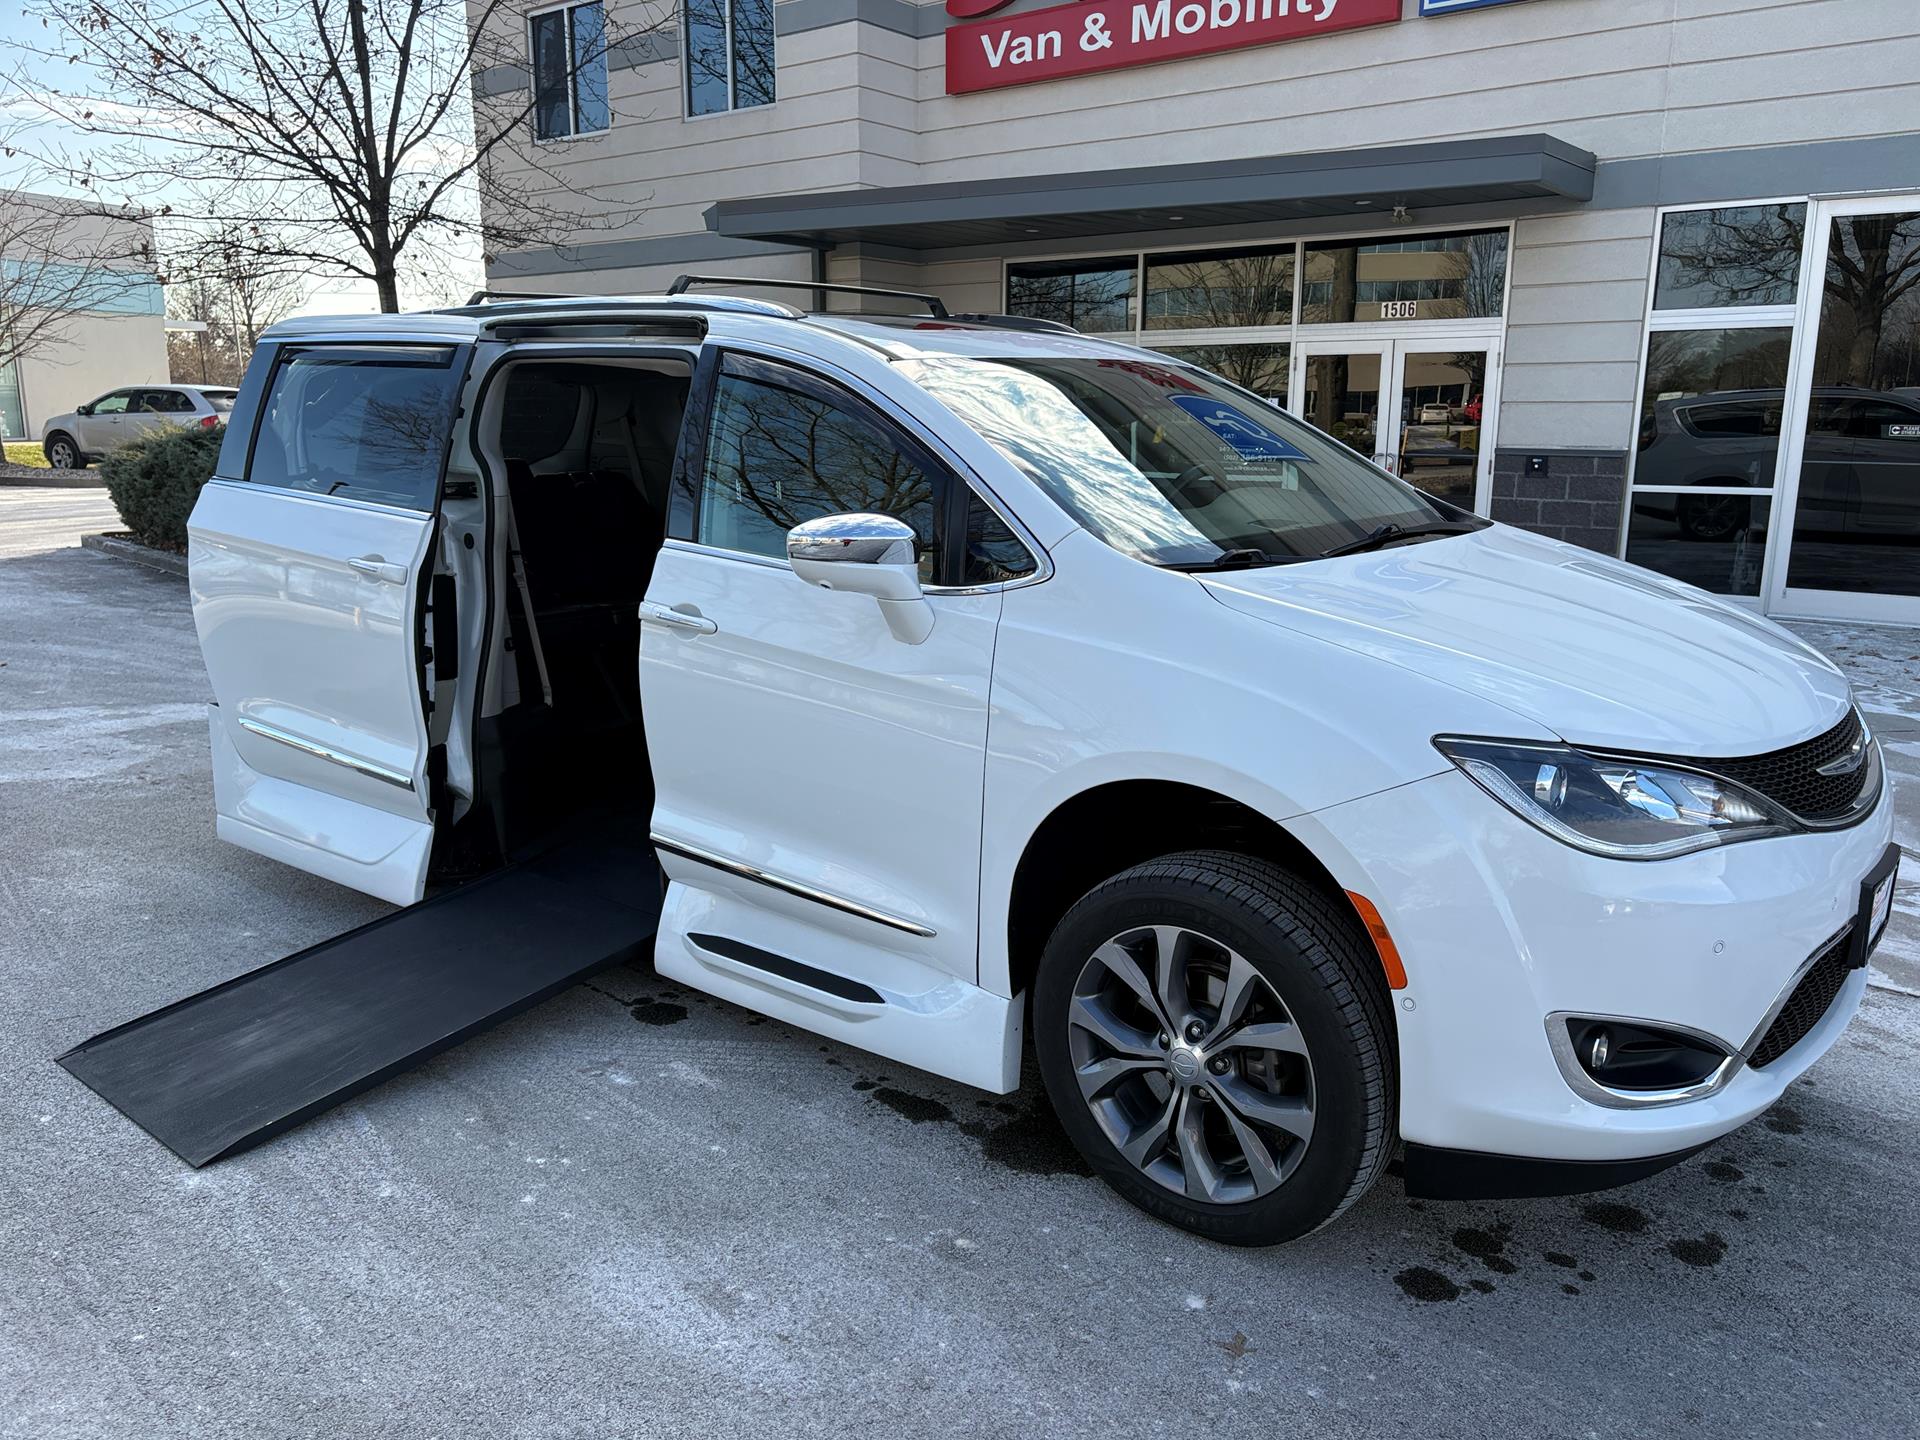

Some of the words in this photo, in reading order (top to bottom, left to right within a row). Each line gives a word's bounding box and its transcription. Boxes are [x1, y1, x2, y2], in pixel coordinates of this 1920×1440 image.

[980, 30, 1062, 68] Van
[1079, 12, 1113, 52] &
[1383, 302, 1415, 317] 1506
